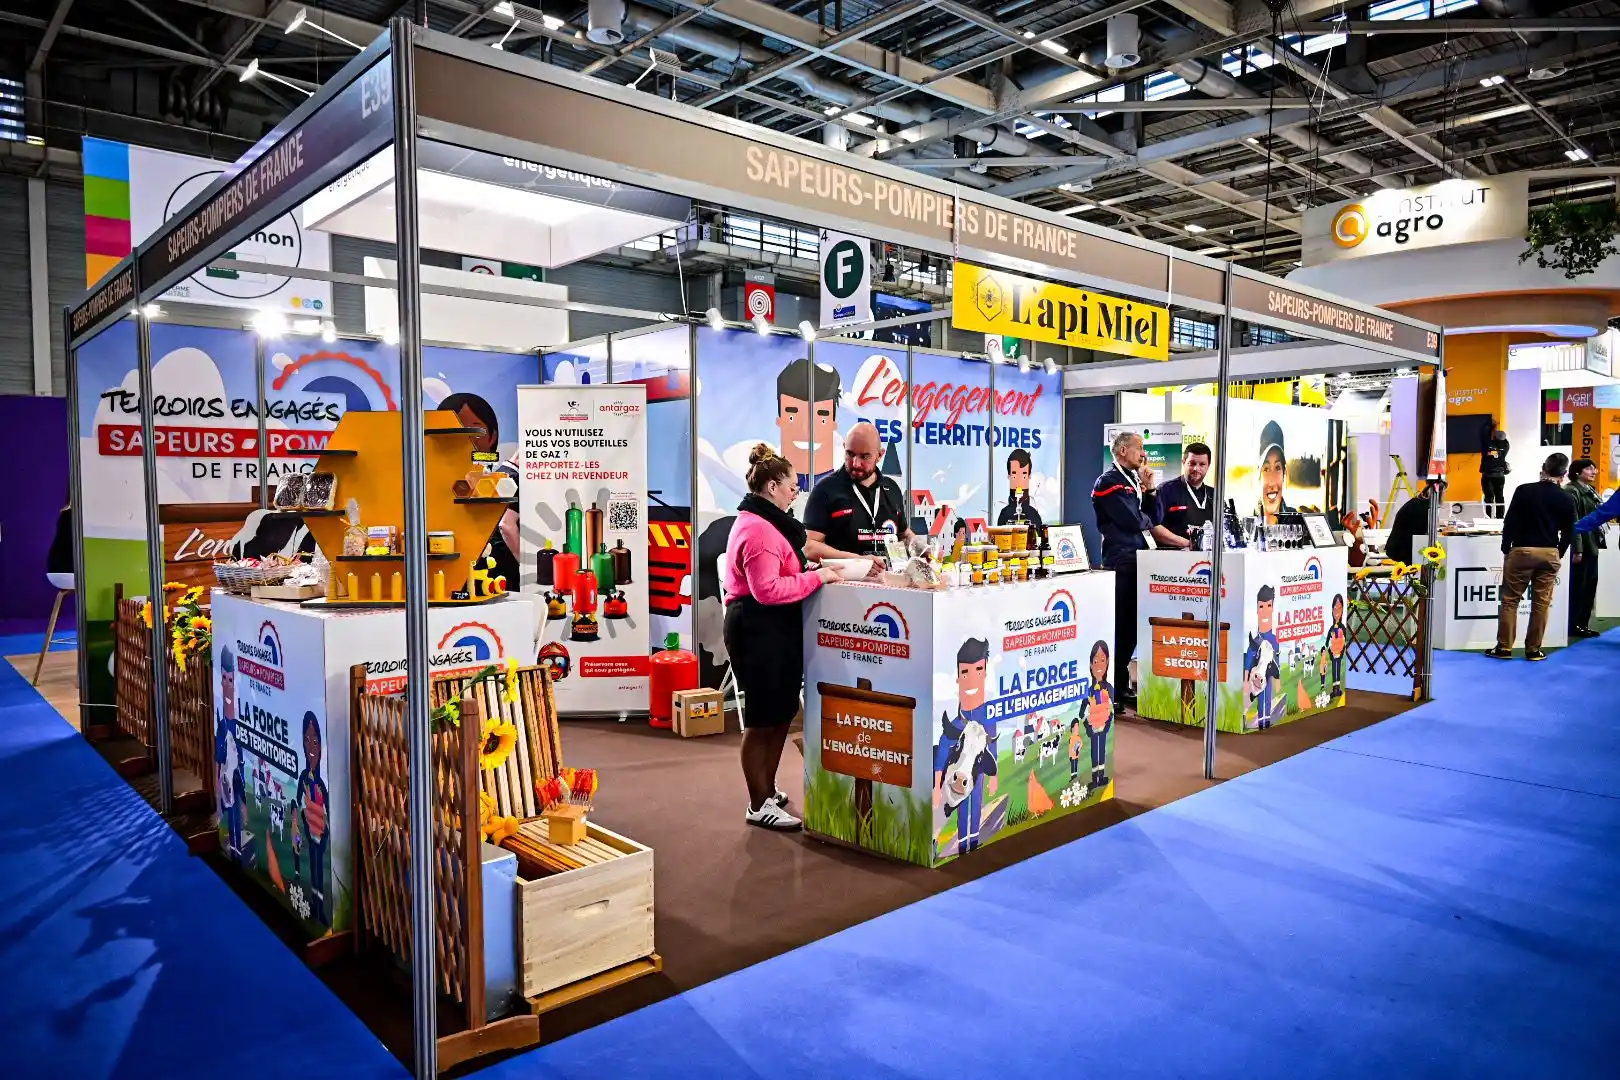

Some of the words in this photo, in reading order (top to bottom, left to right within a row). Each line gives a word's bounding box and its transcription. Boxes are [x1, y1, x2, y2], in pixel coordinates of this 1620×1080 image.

[168, 182, 244, 263] SAPEURS-POMPIERS
[245, 168, 258, 203] DE
[260, 130, 303, 195] FRANCE
[746, 146, 979, 235] SAPEURS-POMPIERS
[985, 210, 1008, 242] DE
[1013, 218, 1077, 258] FRANCE
[1376, 213, 1444, 244] agro
[837, 249, 854, 289] F
[1010, 283, 1089, 340] L'api
[1097, 302, 1158, 347] Miel
[1268, 290, 1354, 331] SAPEURS-POMPIERS
[1355, 314, 1365, 333] DE
[1366, 318, 1393, 341] FRANCE
[1426, 331, 1438, 349] E39
[857, 357, 1044, 430] L'engagement
[1449, 396, 1473, 406] agro
[231, 397, 341, 424] ENGAGÉS
[599, 404, 640, 414] antargaz
[110, 430, 235, 453] SAPEURS
[525, 429, 552, 437] VOUS
[555, 429, 604, 437] N'UTILISEZ
[912, 422, 1042, 449] TERRITOIRES
[525, 440, 548, 448] PLUS
[551, 440, 571, 448] VOS
[573, 439, 628, 448] BOUTEILLES
[525, 451, 538, 459] DE
[541, 451, 561, 459] GAZ
[193, 462, 222, 478] DE
[234, 462, 315, 478] FRANC
[526, 461, 600, 470] RAPPORTEZ-LES
[526, 472, 552, 480] CHEZ
[555, 472, 569, 480] UN
[572, 471, 629, 480] REVENDEUR
[1151, 585, 1181, 594] SAPEURS
[1186, 587, 1209, 596] POMP
[1278, 611, 1291, 625] LA
[1294, 606, 1323, 623] FORCE
[818, 618, 852, 633] TERROIRS
[1278, 627, 1292, 639] DES
[1293, 622, 1322, 637] SECOURS
[820, 635, 855, 649] SAPEURS
[863, 641, 907, 657] POMPIERS
[1005, 636, 1036, 650] SAPEURS
[1042, 628, 1075, 640] POMPIERS
[1163, 636, 1177, 645] LA
[1180, 636, 1209, 647] FORC
[429, 650, 473, 666] NGAGÉS
[841, 651, 851, 660] DE
[853, 653, 883, 664] FRANCE
[1024, 649, 1032, 657] DE
[1033, 644, 1057, 655] FRANCE
[1180, 648, 1199, 658] des
[1165, 658, 1208, 669] SECOUR
[1000, 673, 1022, 696] LA
[1027, 660, 1078, 690] FORCE
[986, 702, 1003, 719] DE
[1005, 682, 1088, 714] L'ENGAGEMENT
[238, 698, 250, 726] LA
[252, 705, 289, 745] FORCE
[836, 713, 851, 726] LA
[854, 715, 893, 733] FORCE
[857, 731, 872, 744] de
[236, 724, 248, 745] DES
[249, 732, 297, 773] TERRITOIRES
[822, 738, 910, 766] L'ENGAGEMENT
